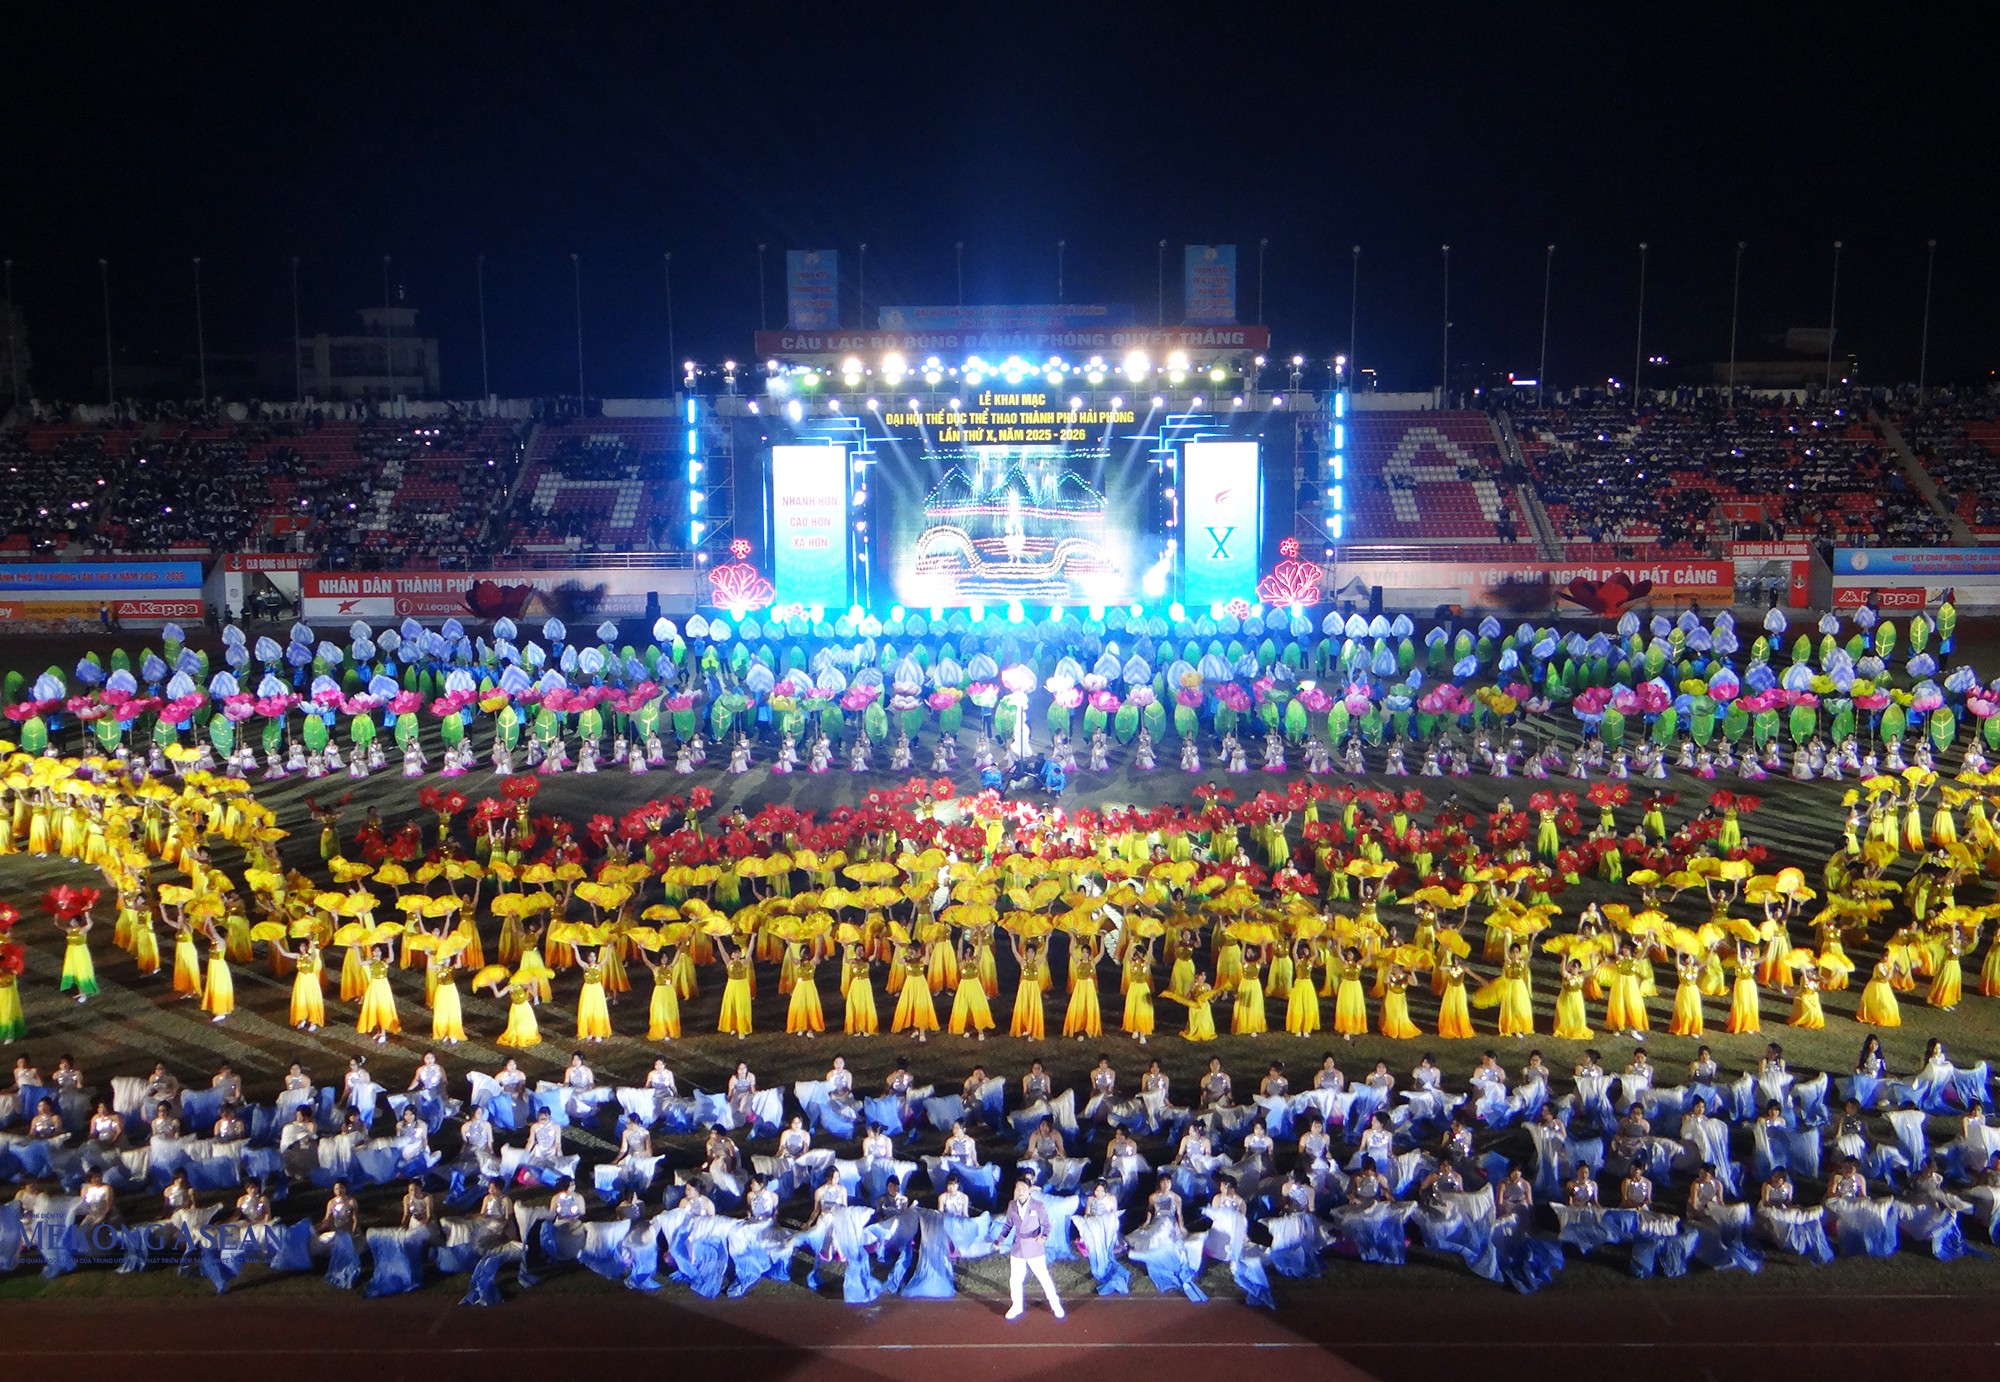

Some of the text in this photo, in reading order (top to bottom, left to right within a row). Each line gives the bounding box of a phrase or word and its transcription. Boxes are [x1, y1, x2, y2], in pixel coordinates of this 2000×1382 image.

[828, 336, 865, 351] LẠC
[903, 332, 959, 349] BÓNG
[1037, 331, 1105, 348] PHÒNG
[1178, 328, 1245, 346] THẮNG
[979, 390, 1046, 408] LỄ KHAI MẠC
[885, 408, 1135, 427] ĐẠI HỘI THỂ DỤC THỂ THAO THÀNH PHỐ HẢI PHÒNG
[938, 427, 961, 442] LẦN
[963, 427, 984, 441] THỨ
[985, 430, 998, 443] X,
[998, 427, 1024, 442] NĂM
[1025, 429, 1052, 441] 2025
[1060, 428, 1087, 441] 2026
[1382, 427, 1502, 522] A
[782, 496, 838, 506] NHANH HƠN
[790, 517, 831, 527] CAO HƠN
[793, 537, 828, 548] XA HƠN
[1204, 526, 1238, 559] X
[1732, 544, 1745, 555] CLB
[139, 571, 159, 581] 2025
[166, 571, 185, 581] 2026
[1450, 571, 1474, 585] TIN
[1549, 567, 1598, 584] NGƯỜI
[1639, 565, 1670, 584] ĐẤT
[1673, 565, 1718, 584] CẢNG
[318, 576, 359, 594] NHÂN
[362, 576, 393, 594] DÂN
[396, 576, 443, 593] THÀNH
[446, 574, 474, 593] PHỐ
[139, 602, 199, 615] Kappa
